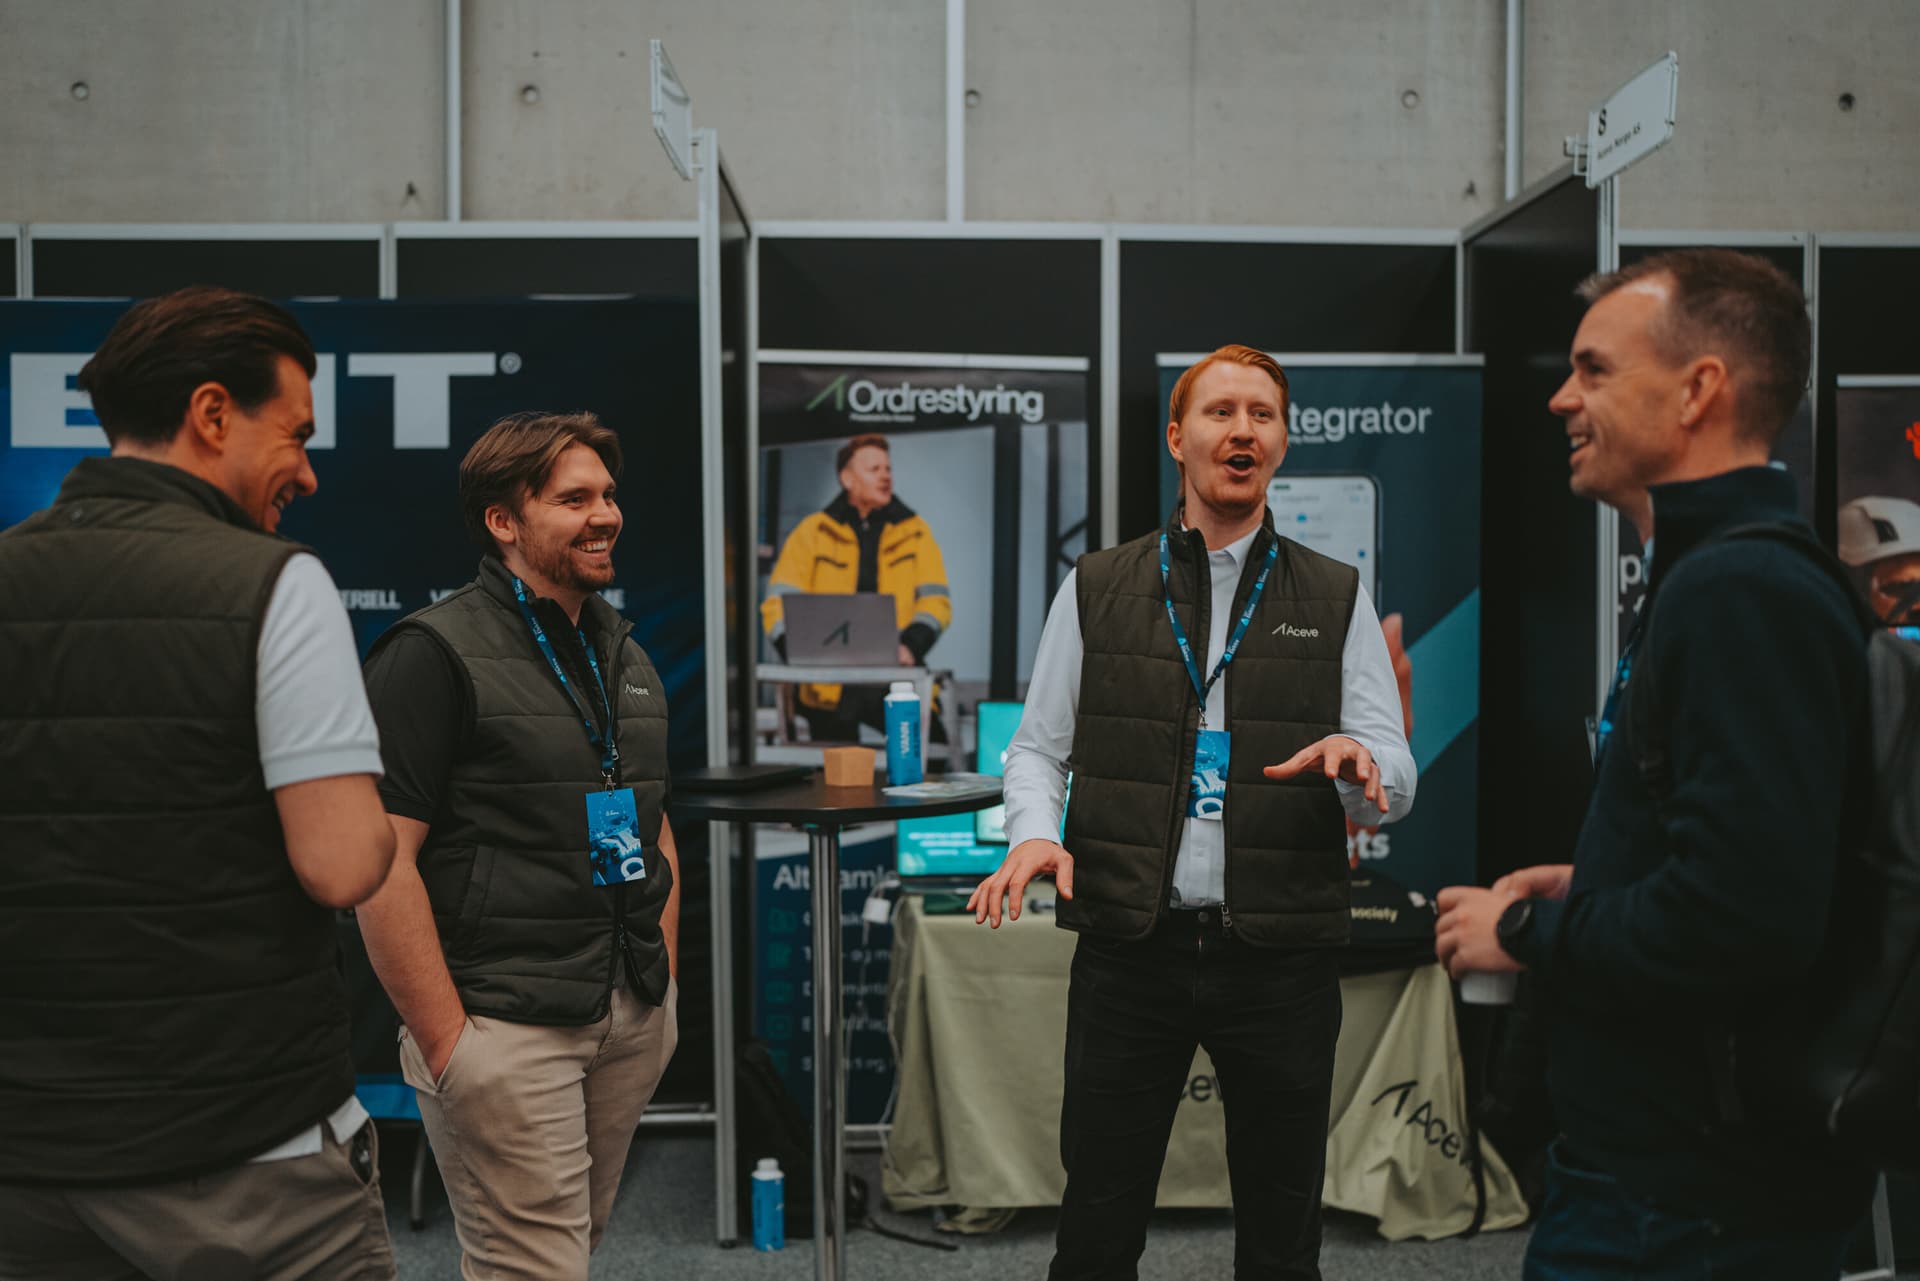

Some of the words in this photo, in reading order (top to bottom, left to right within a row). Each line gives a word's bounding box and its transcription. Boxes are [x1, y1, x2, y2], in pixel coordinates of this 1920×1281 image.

[848, 380, 1044, 423] Ordrestyring
[1289, 401, 1432, 442] tegrator
[1286, 624, 1319, 638] Aceve
[1406, 1100, 1466, 1166] Ace
